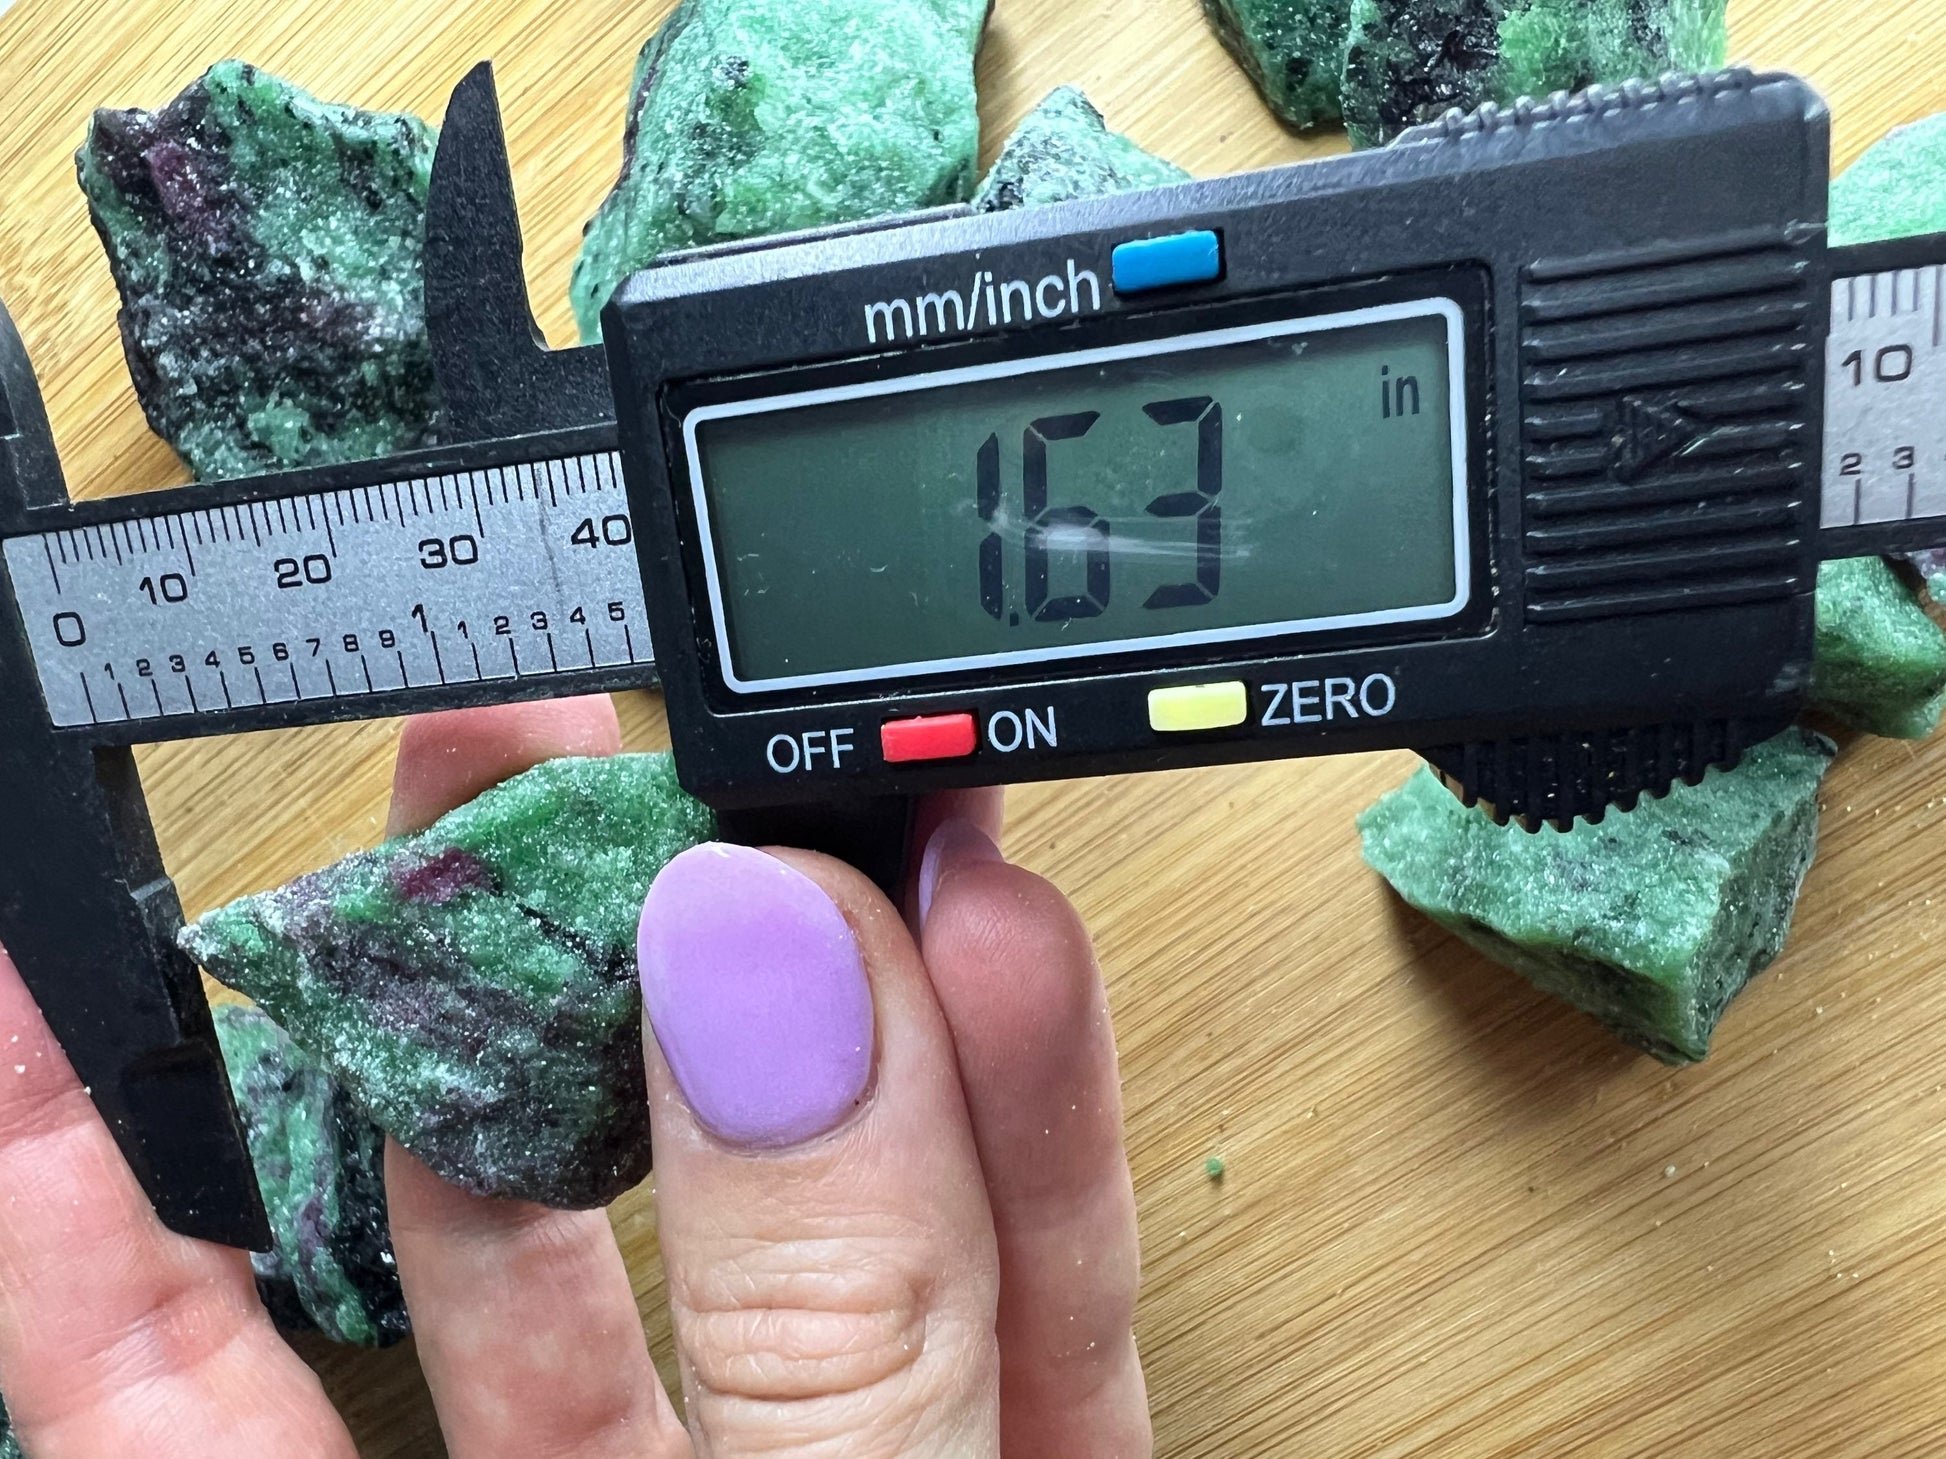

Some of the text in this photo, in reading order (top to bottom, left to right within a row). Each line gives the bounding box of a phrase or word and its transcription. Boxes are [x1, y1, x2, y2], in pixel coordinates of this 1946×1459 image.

[864, 259, 1101, 344] mm/inch
[1381, 364, 1421, 419] in
[1838, 445, 1916, 477] 2 3
[975, 395, 1224, 628] 1.63
[52, 513, 633, 648] 0 10 20 30 40
[103, 600, 626, 681] 1 2 3 4 5 6 7 8 9 1 1 2 3 4 5
[1260, 672, 1397, 728] ZERO
[766, 706, 1059, 774] OFF ON
